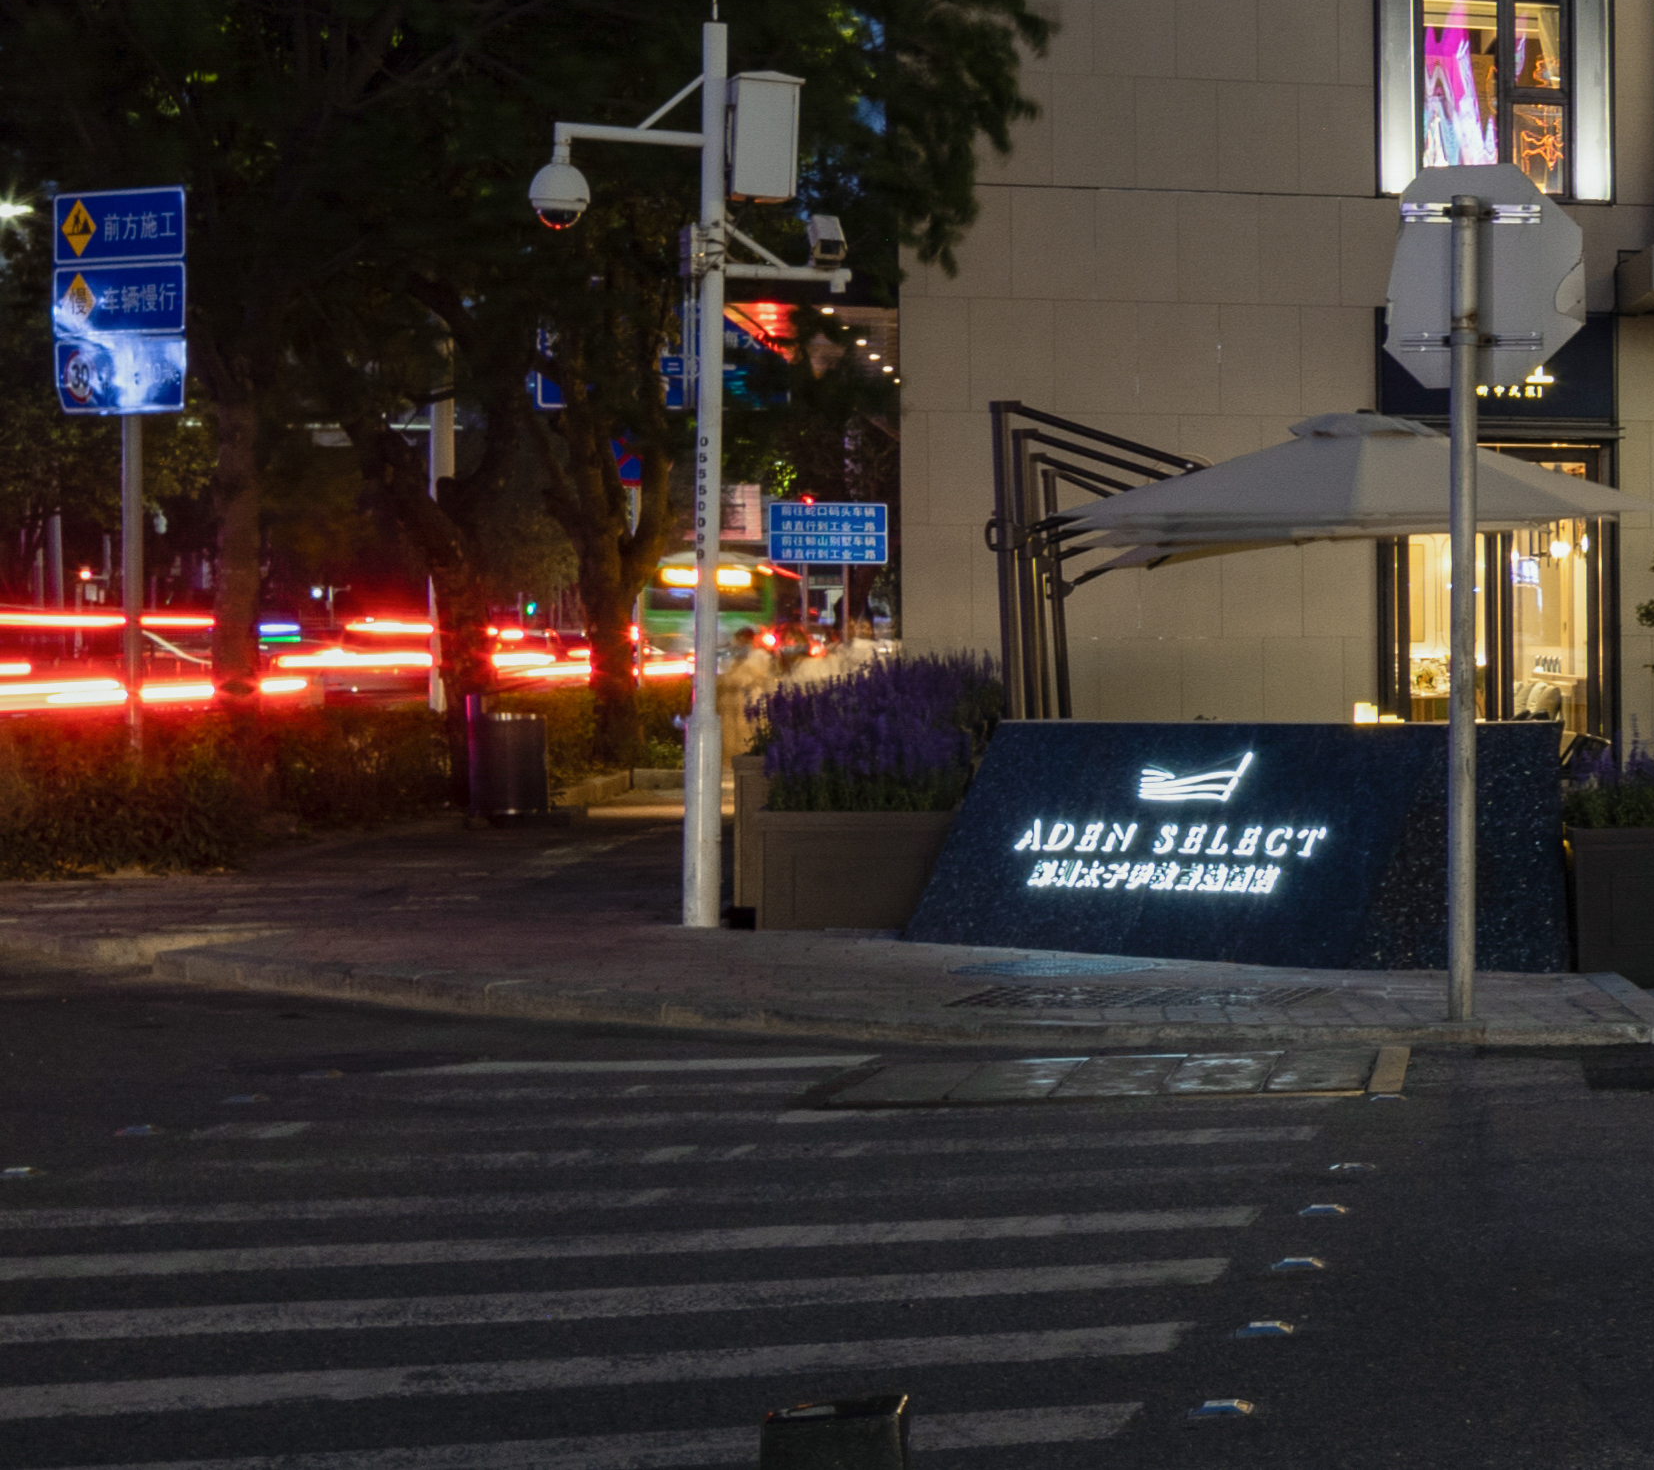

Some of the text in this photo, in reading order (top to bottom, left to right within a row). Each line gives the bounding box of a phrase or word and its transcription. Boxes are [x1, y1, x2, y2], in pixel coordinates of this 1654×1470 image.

[103, 211, 177, 242] 前方施工
[70, 286, 88, 316] 慢
[102, 282, 177, 314] 车辆慢行
[1013, 817, 1328, 858] ADEN SELECT
